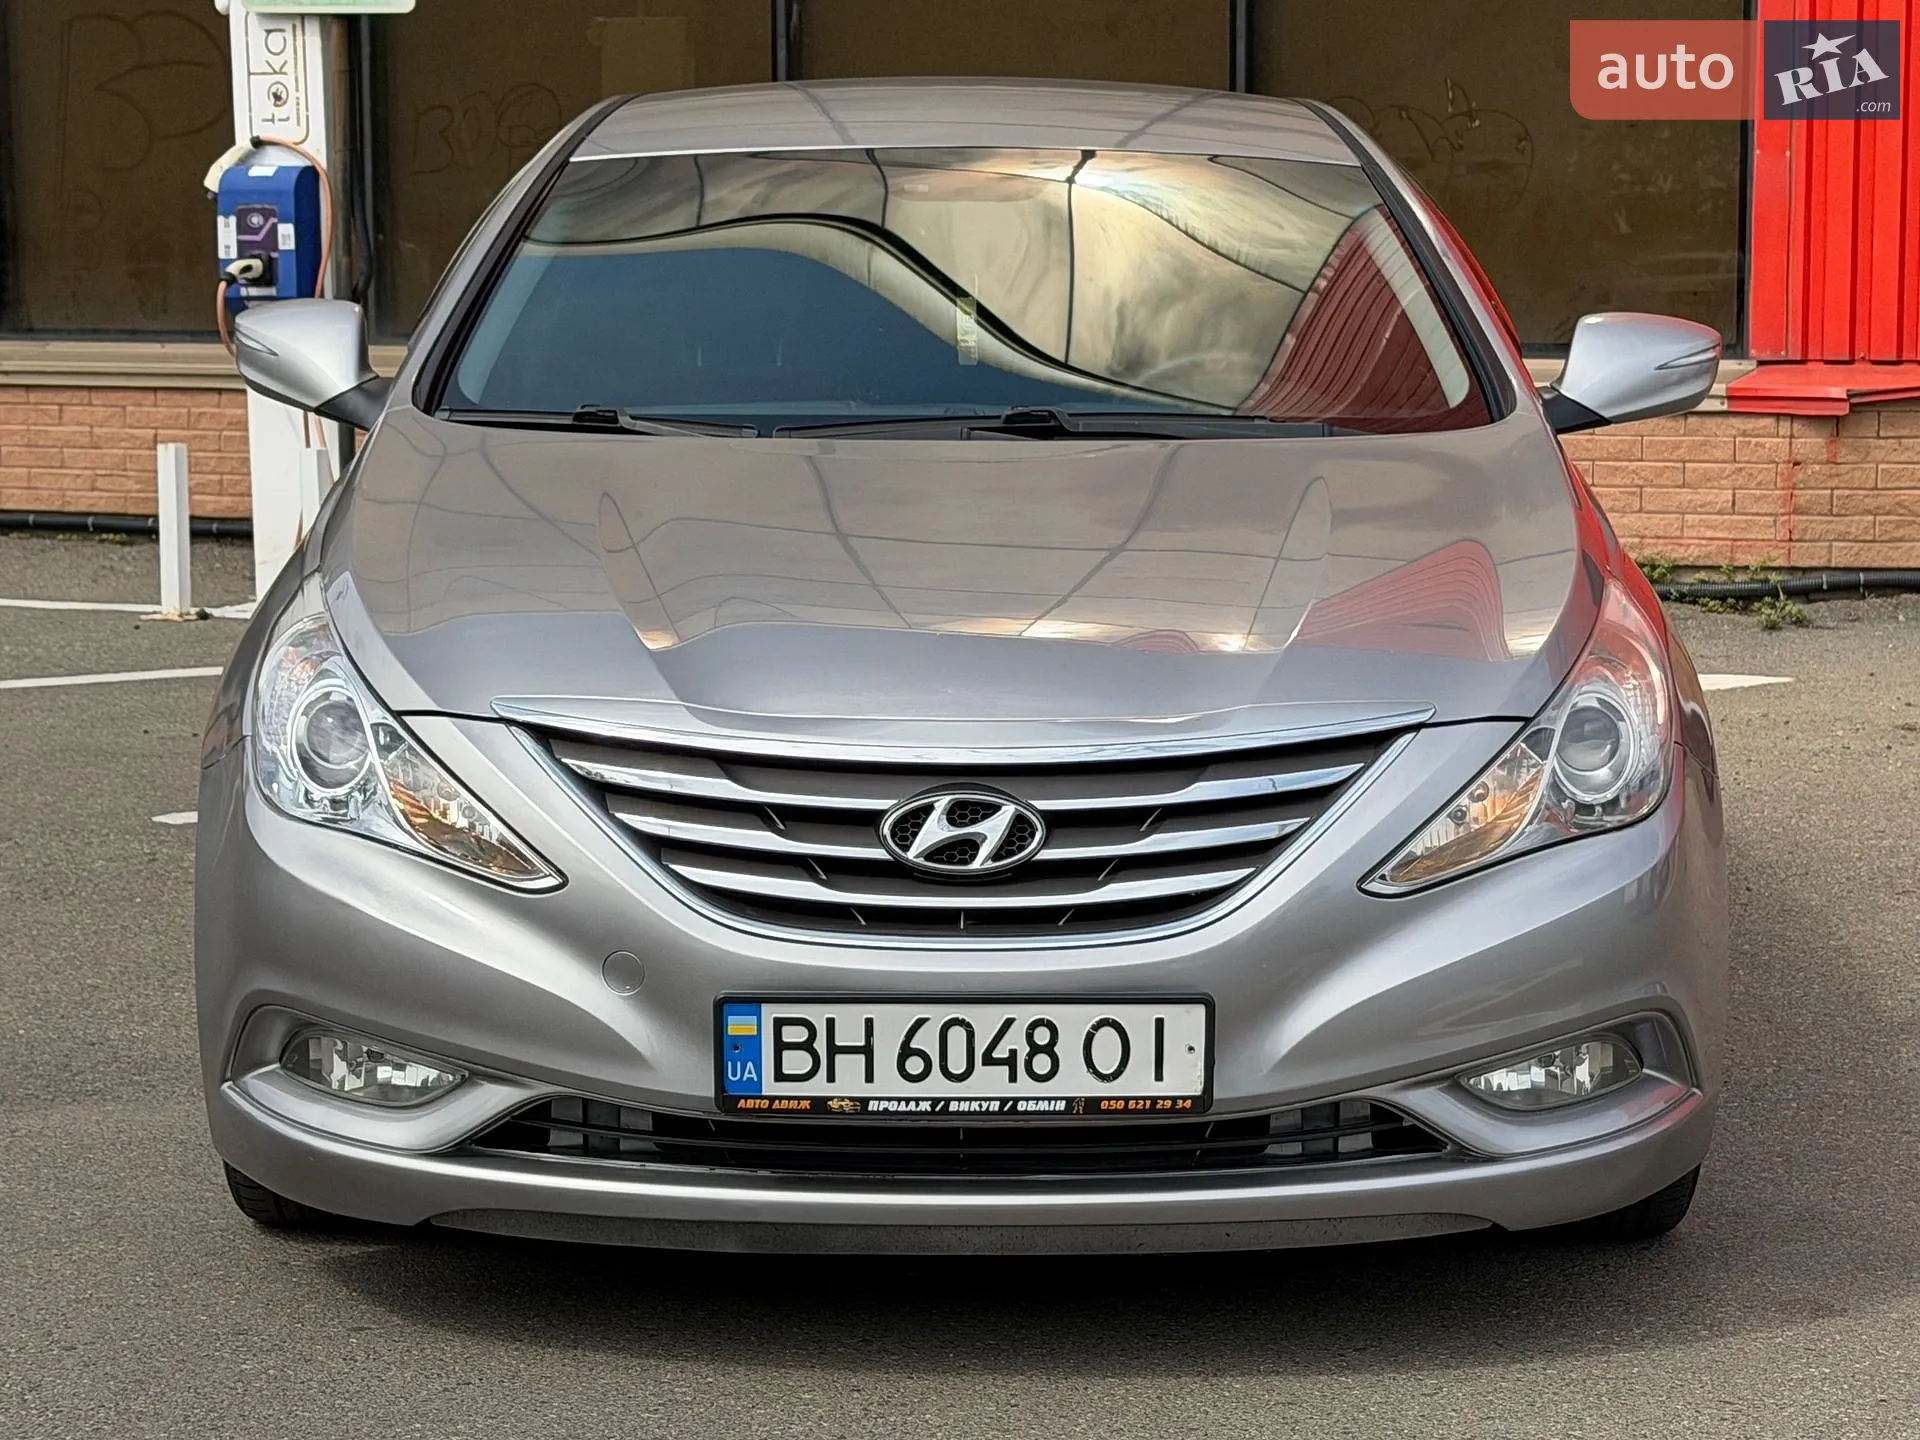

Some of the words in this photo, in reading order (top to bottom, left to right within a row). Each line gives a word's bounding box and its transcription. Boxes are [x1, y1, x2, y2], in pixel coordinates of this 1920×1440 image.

[248, 28, 291, 125] toka
[772, 1016, 875, 1084] BH
[896, 1016, 1060, 1084] 6048
[1082, 1016, 1165, 1083] OI
[727, 1061, 758, 1081] UA
[737, 1099, 770, 1109] АВТО
[771, 1099, 811, 1110] ДВИЖ
[867, 1100, 932, 1112] ПРОДАЖ
[949, 1100, 1000, 1112] ВИКУП
[1017, 1100, 1066, 1112] ОБМІН
[1100, 1099, 1126, 1110] 050
[1155, 1099, 1173, 1109] 29
[1175, 1099, 1192, 1109] 34
